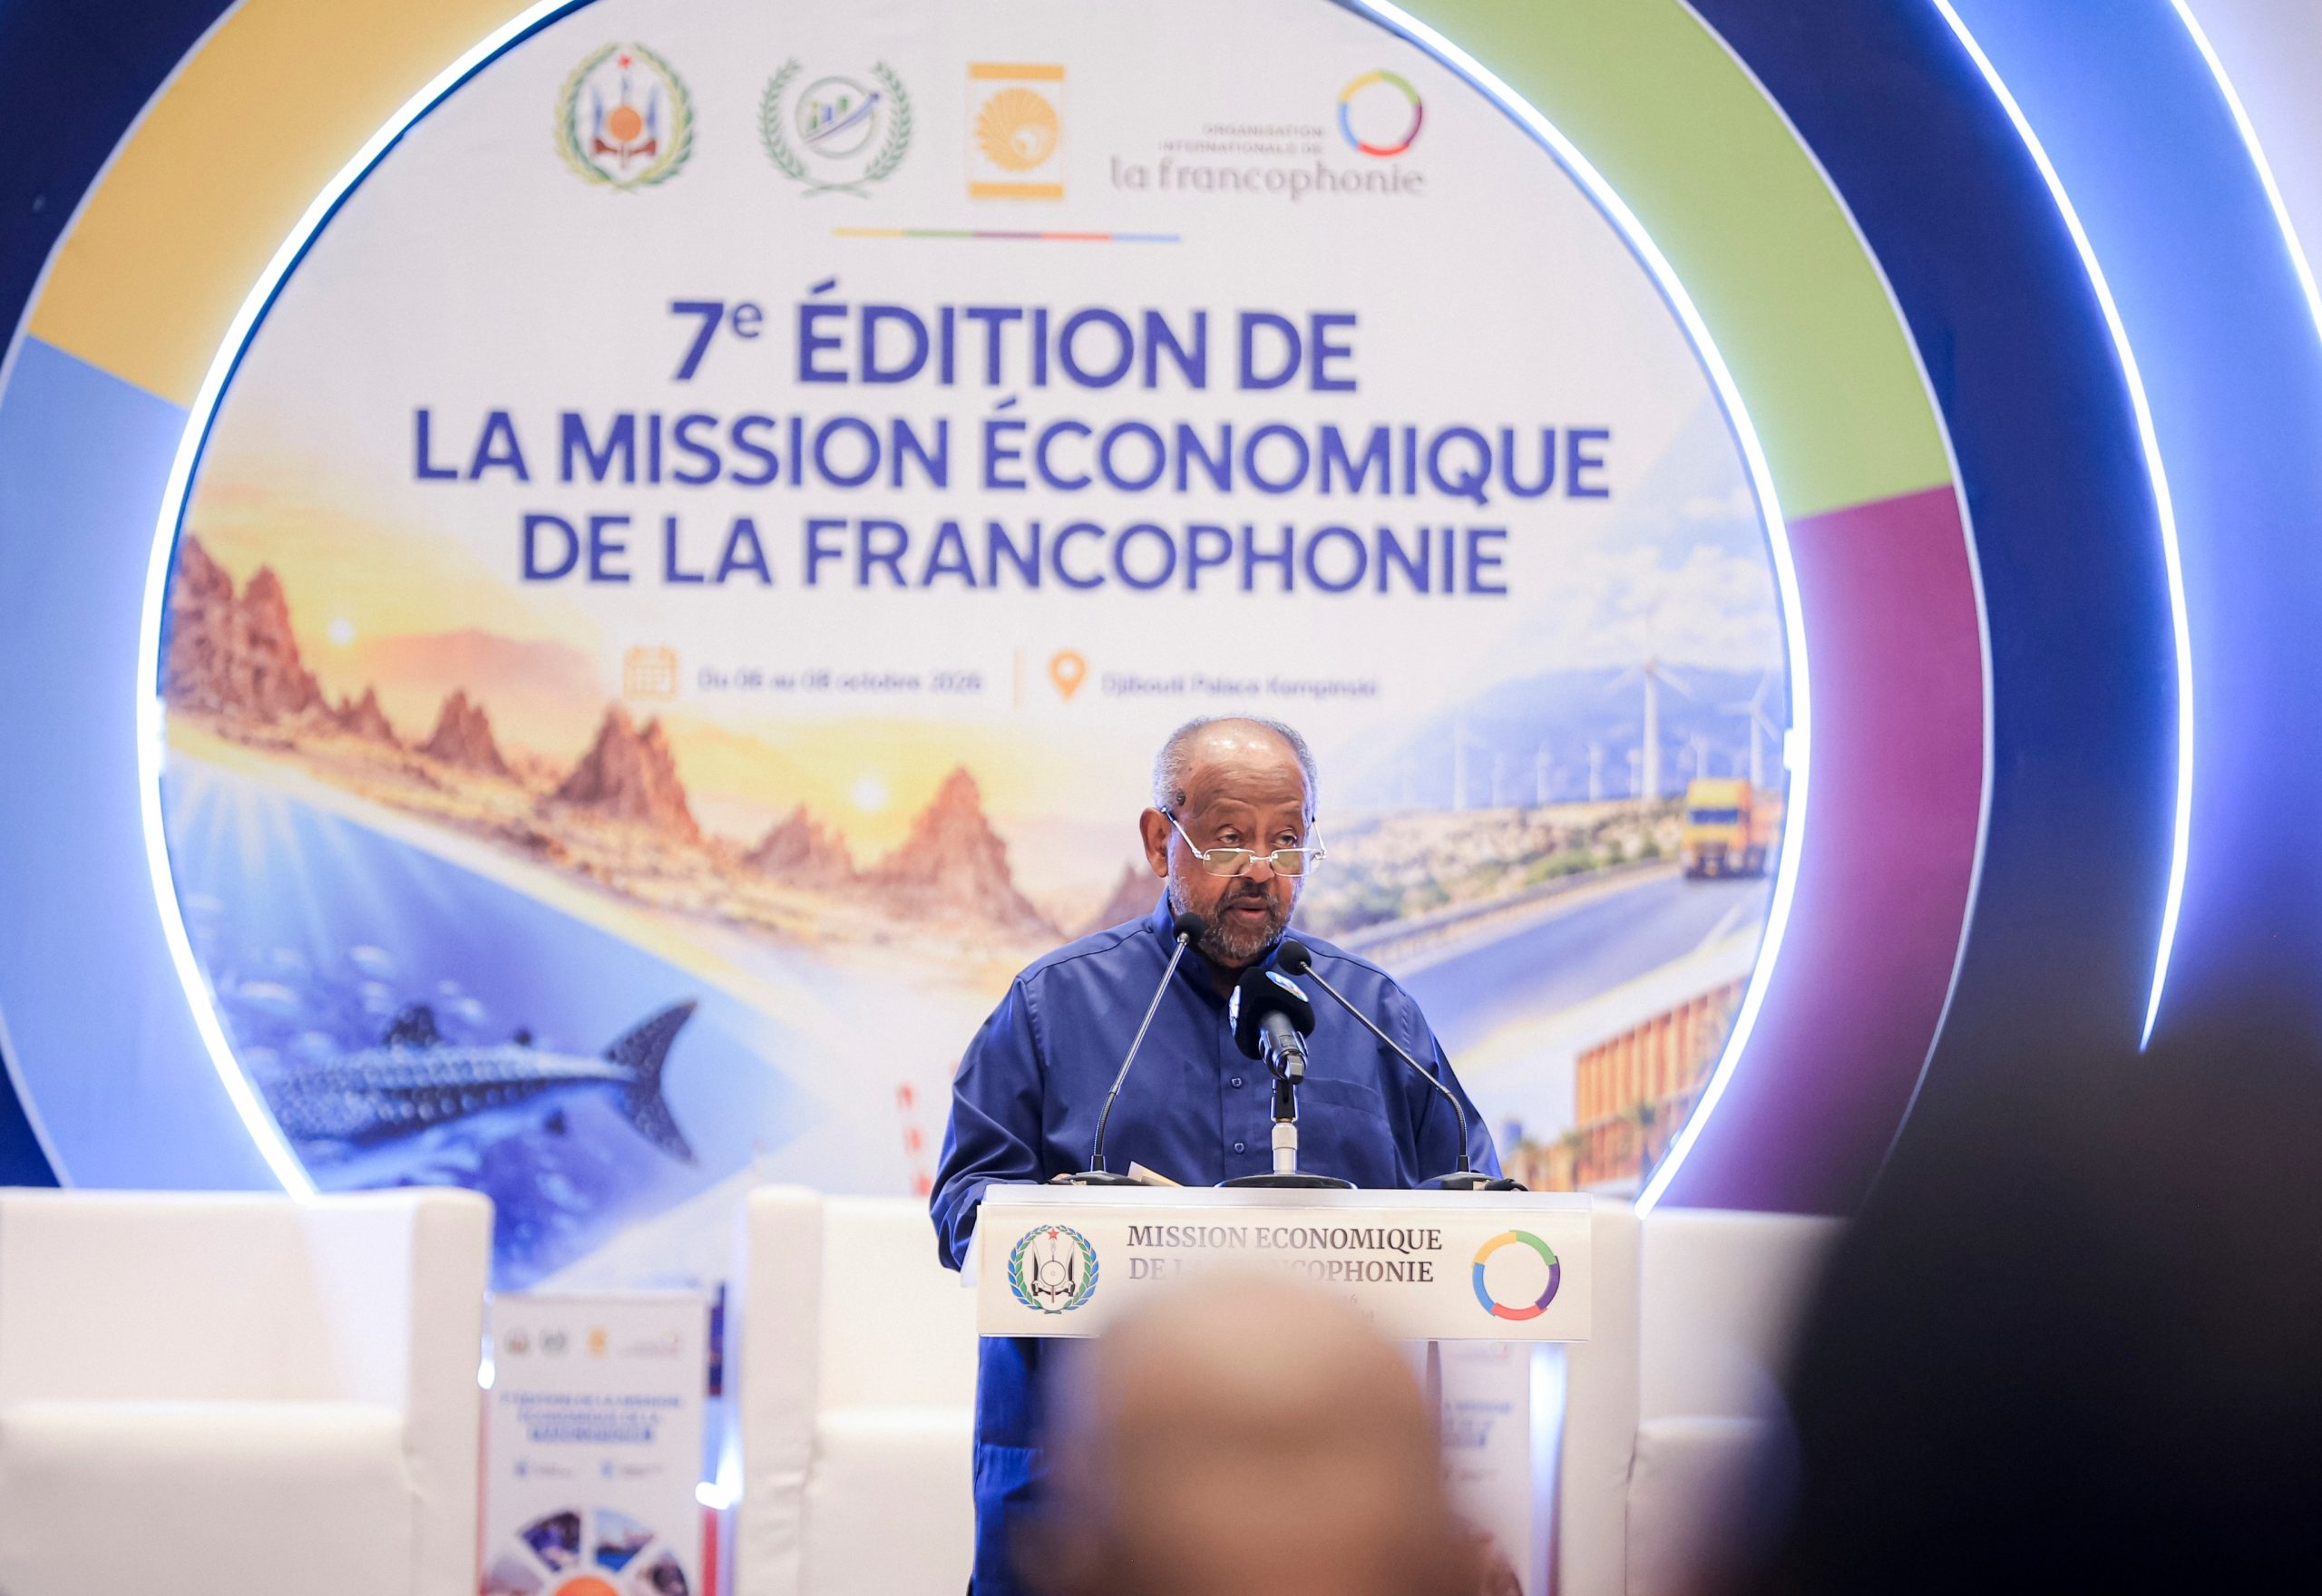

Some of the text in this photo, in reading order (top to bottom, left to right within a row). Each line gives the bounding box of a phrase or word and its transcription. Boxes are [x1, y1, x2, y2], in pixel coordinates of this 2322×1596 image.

[1109, 155, 1425, 203] la francophonie
[669, 277, 1358, 394] 7e ÉDITION DE
[414, 395, 1611, 508] LA MISSION ÉCONOMIQUE
[521, 511, 1508, 596] DE LA FRANCOPHONIE
[1127, 1225, 1443, 1254] MISSION ECONOMIQUE
[1128, 1258, 1167, 1280] DE
